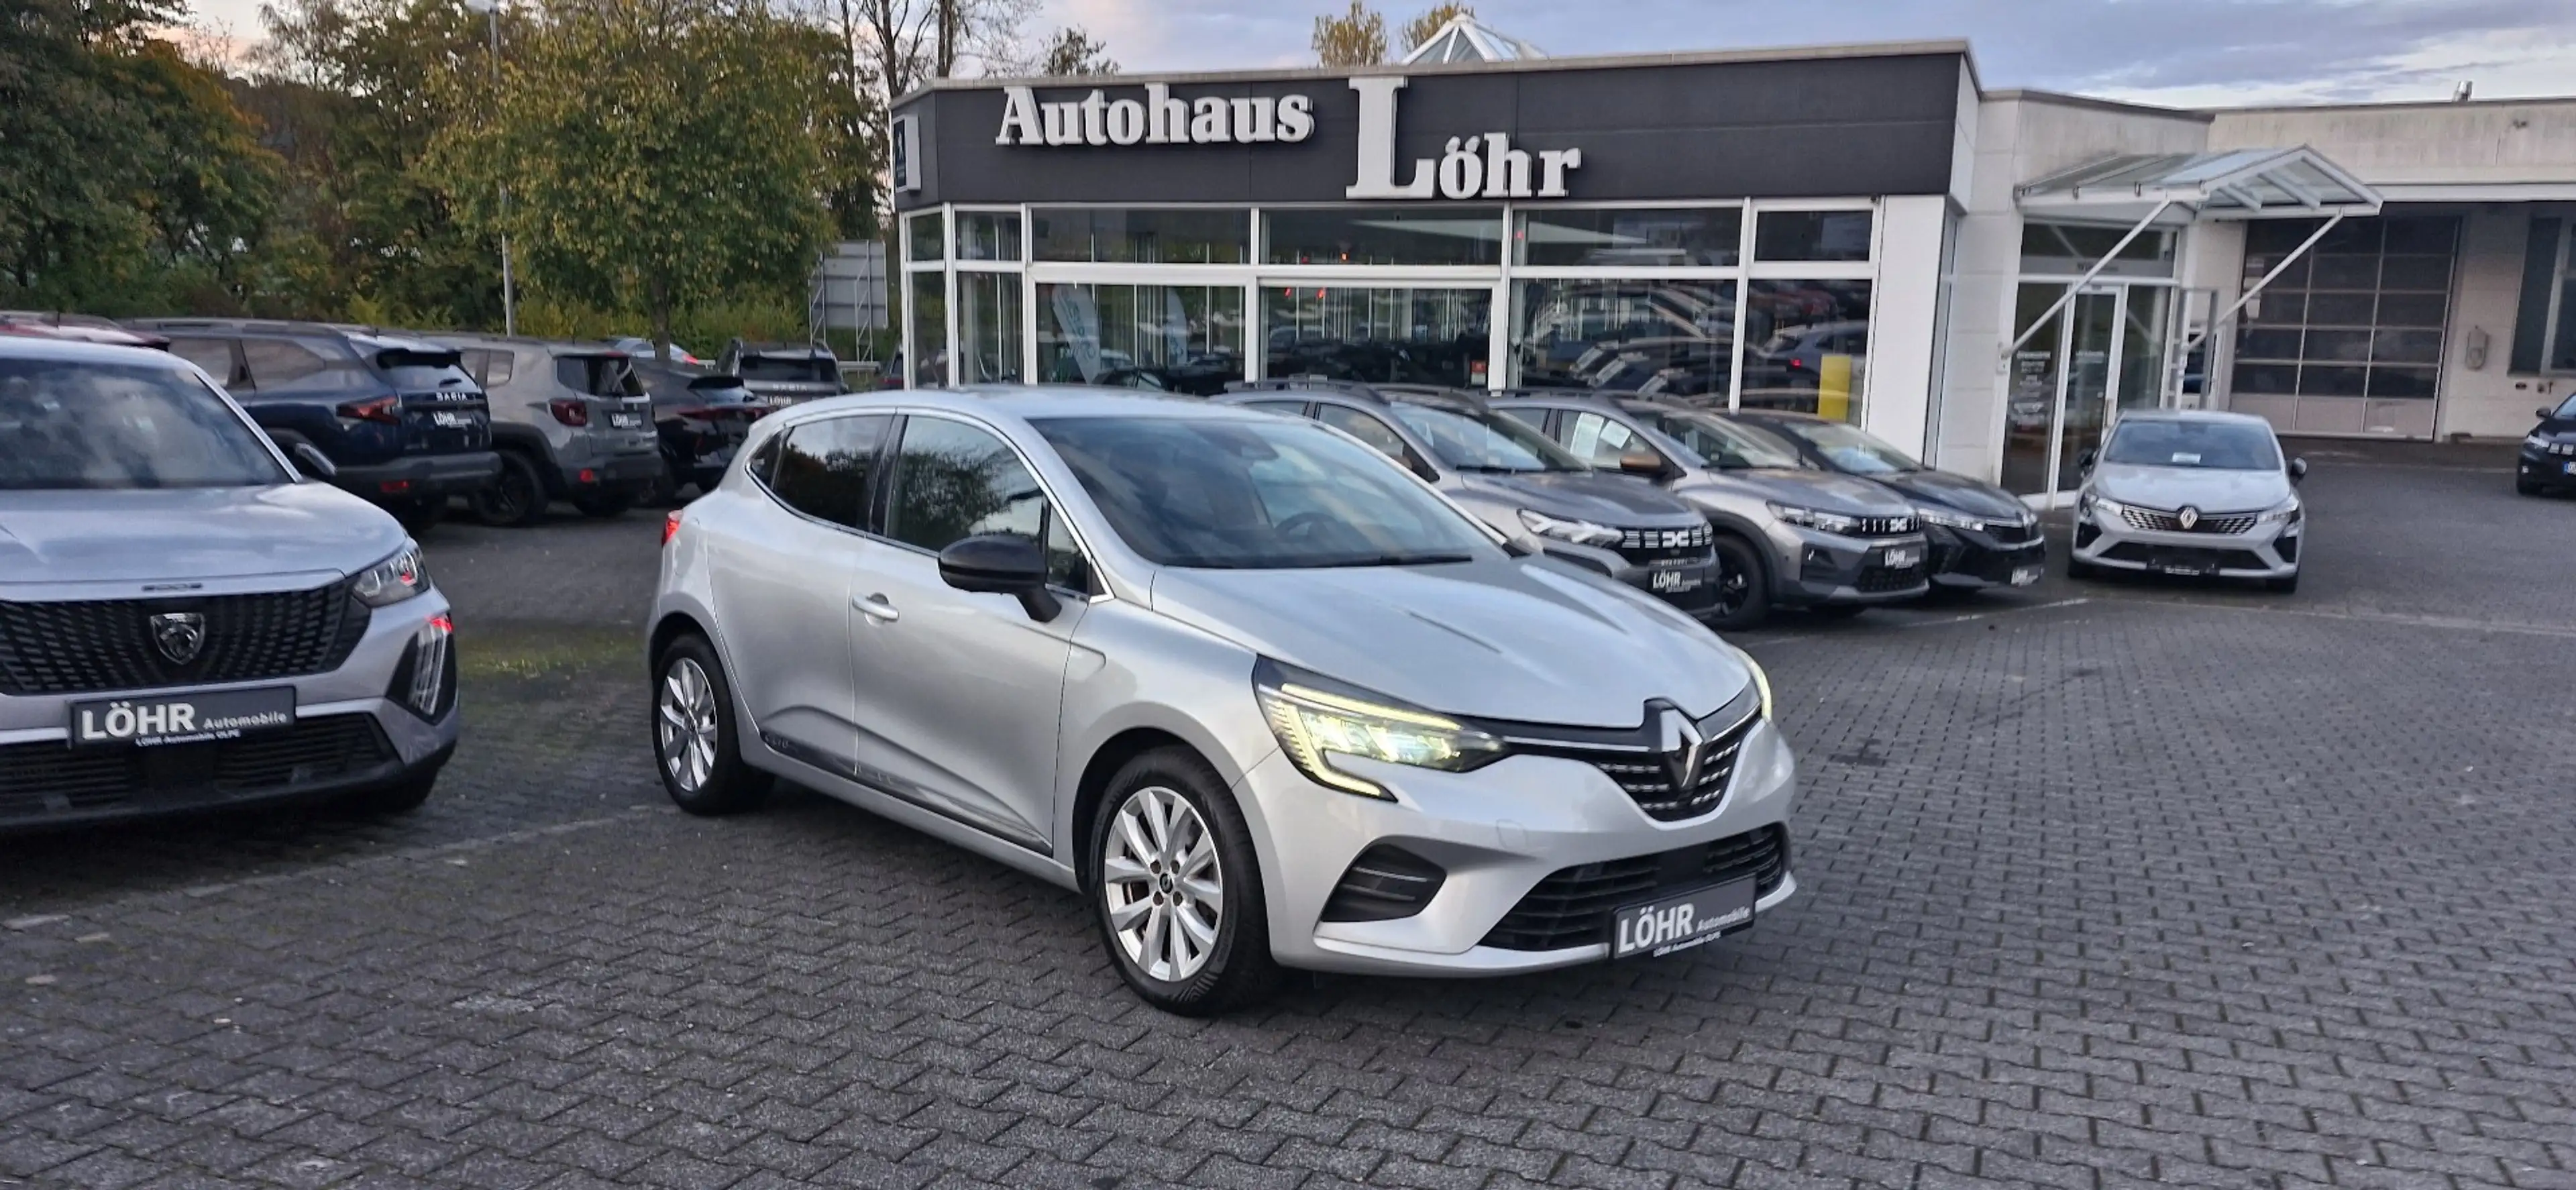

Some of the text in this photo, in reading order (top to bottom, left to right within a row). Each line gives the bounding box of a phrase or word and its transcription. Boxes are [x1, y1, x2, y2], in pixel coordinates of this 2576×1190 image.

[996, 75, 1582, 199] Autohaus Löhr
[1653, 569, 1681, 589] LÖHR
[82, 702, 287, 739] LÖHR Automobile
[1618, 904, 1750, 953] LÖHR Automobile
